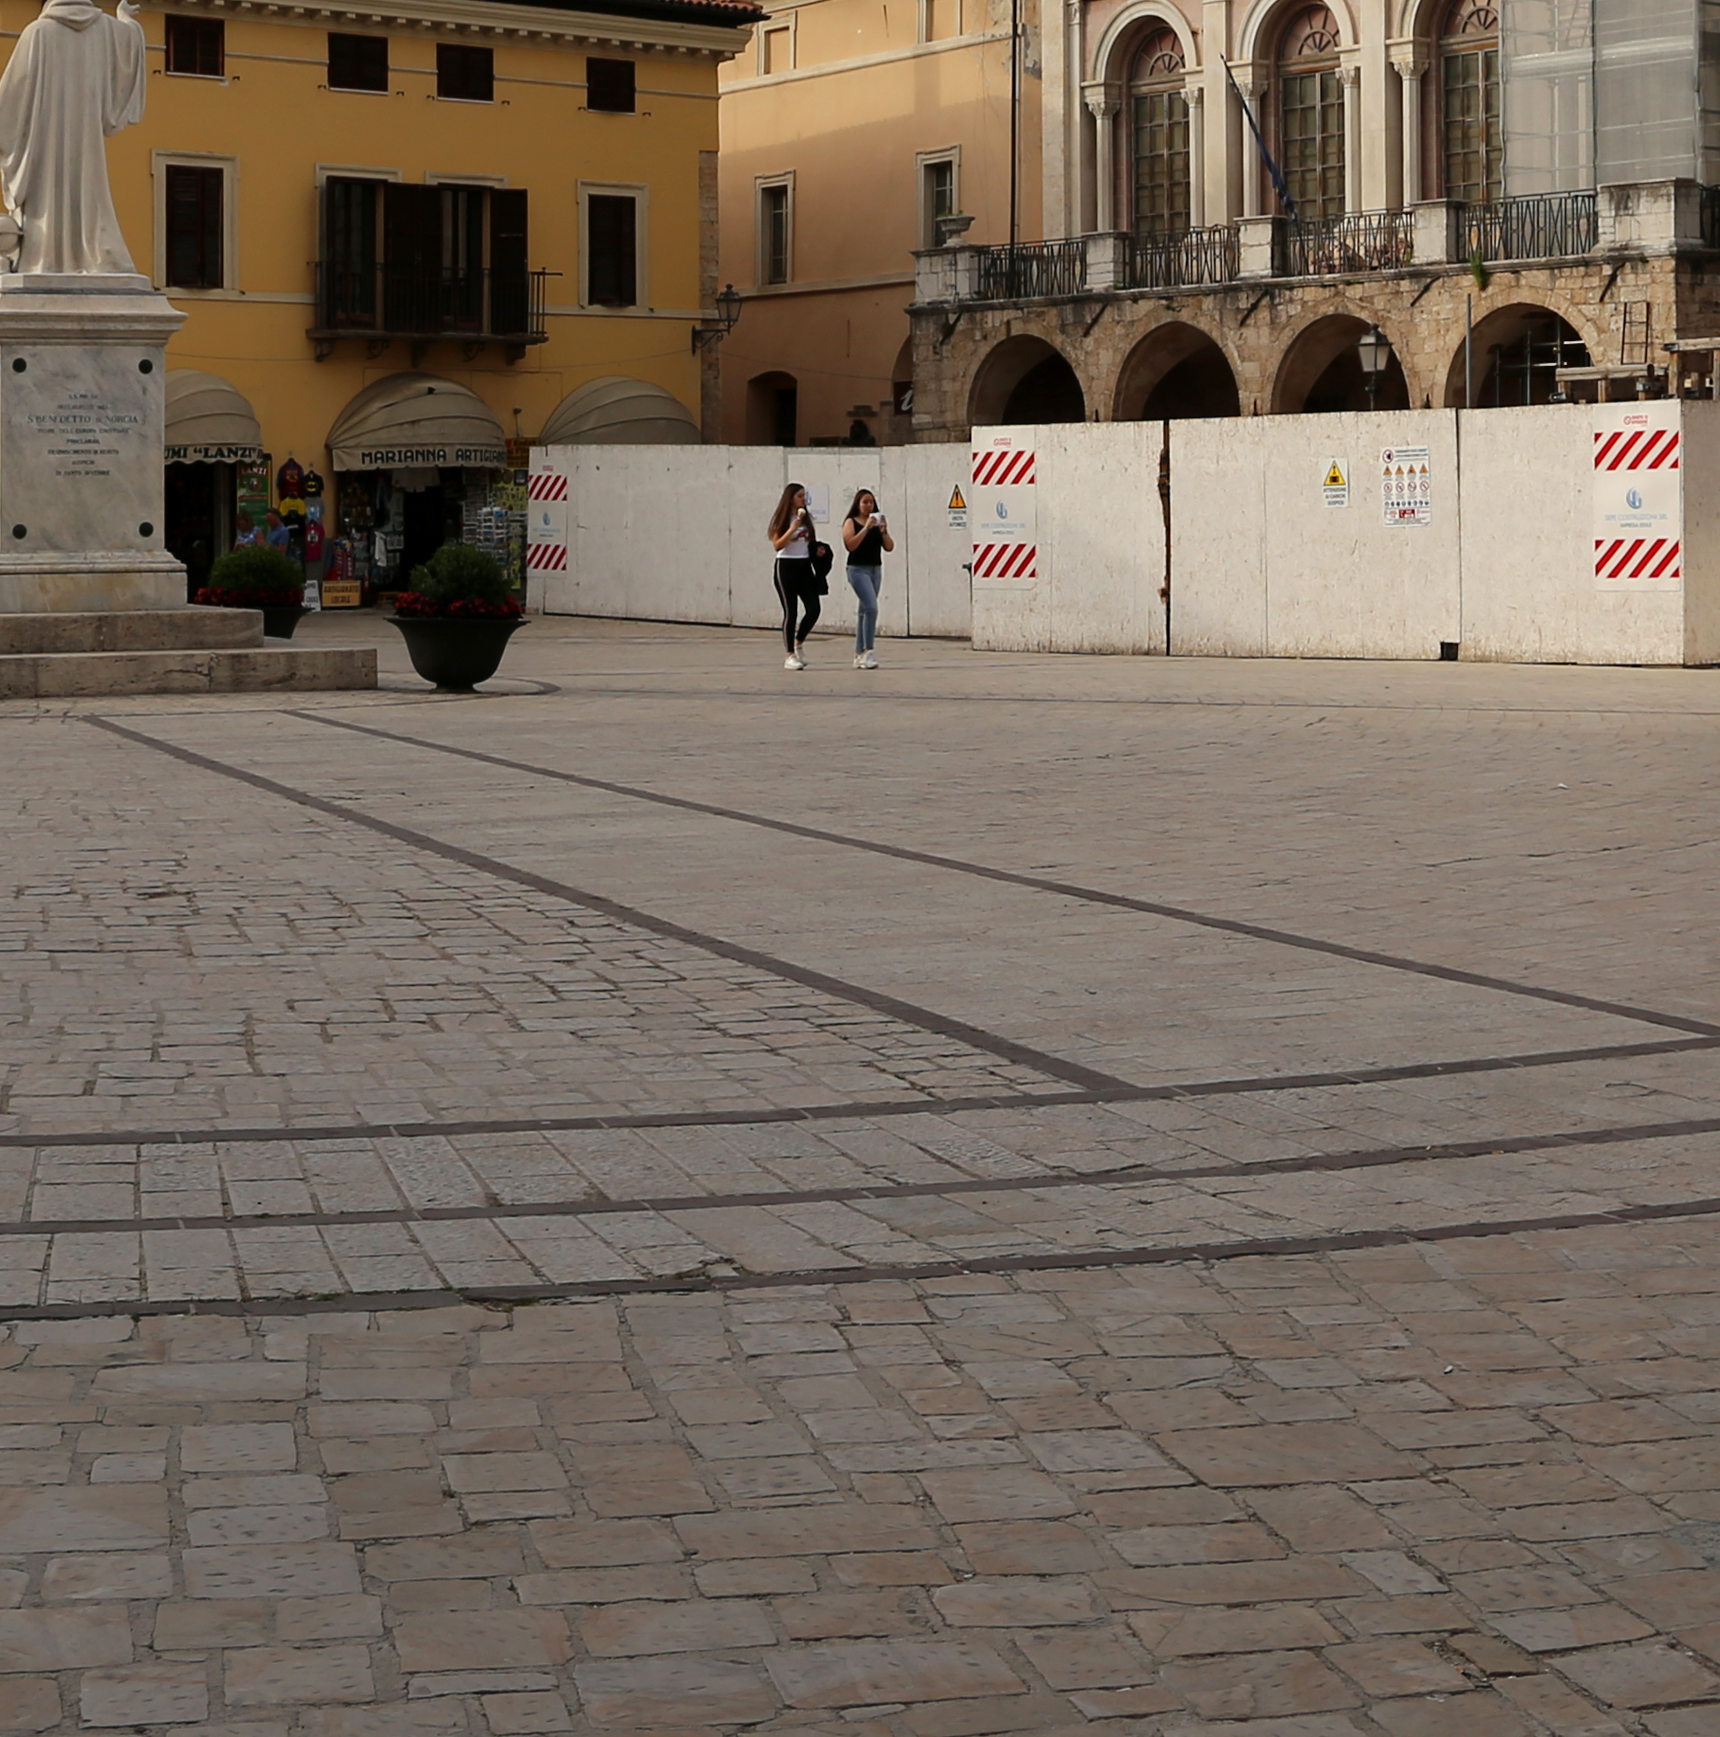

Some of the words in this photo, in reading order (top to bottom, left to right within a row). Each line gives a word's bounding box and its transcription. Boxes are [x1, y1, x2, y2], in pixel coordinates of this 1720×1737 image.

[35, 414, 91, 424] BENEDETTO
[105, 414, 138, 424] NORCIA
[361, 449, 447, 465] MARIANNA
